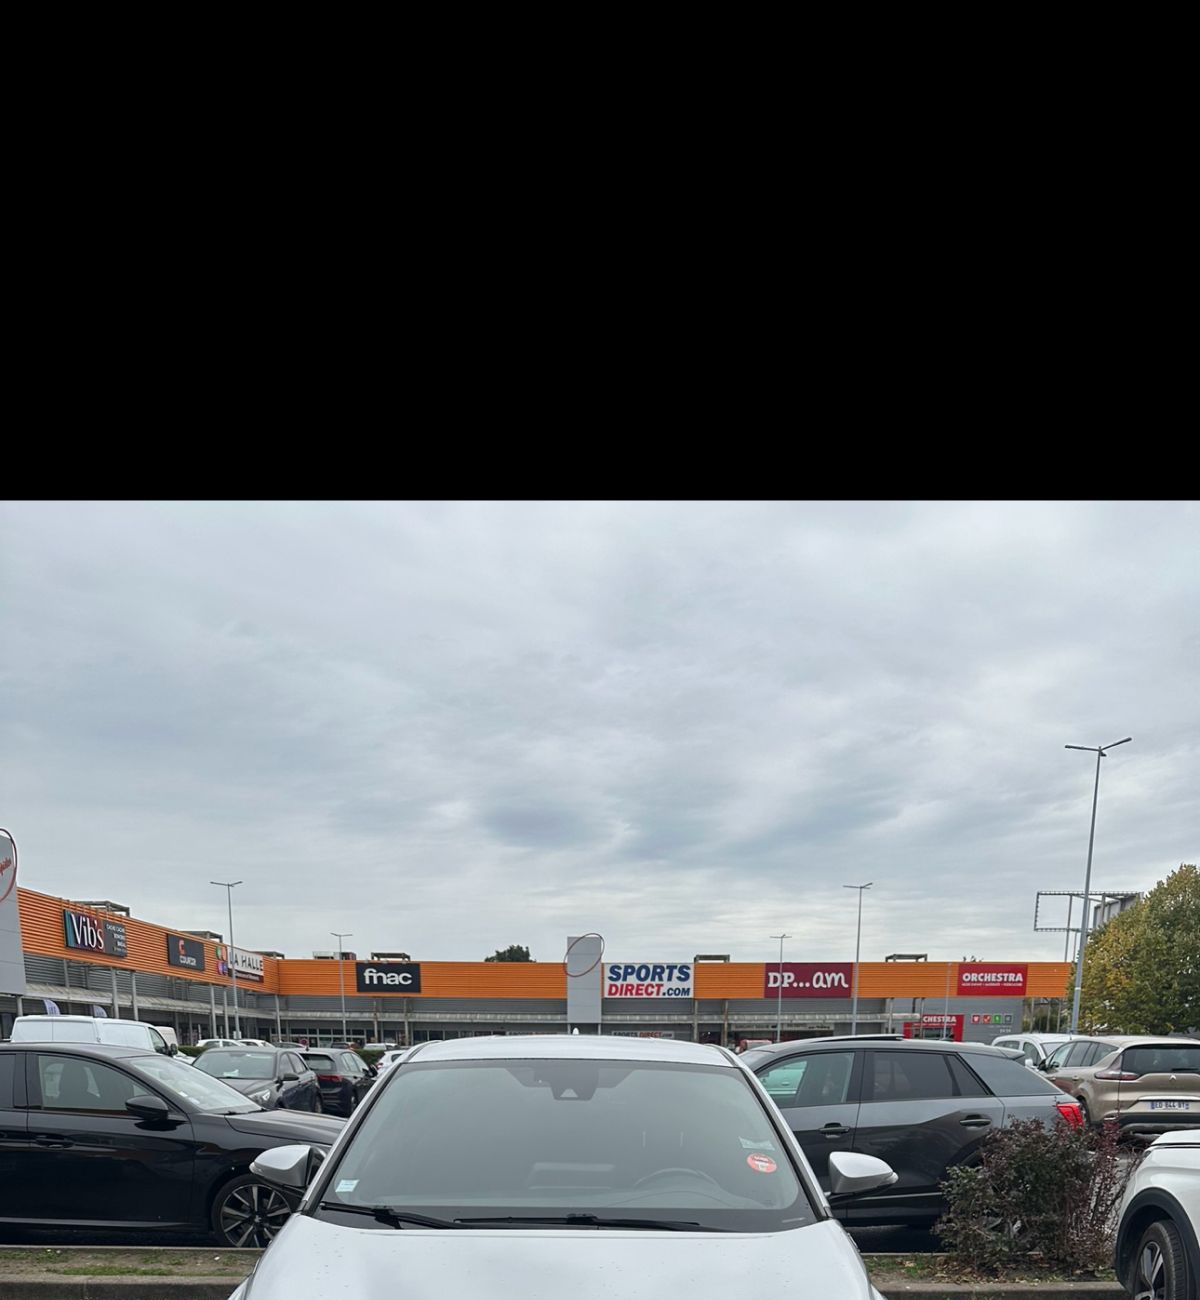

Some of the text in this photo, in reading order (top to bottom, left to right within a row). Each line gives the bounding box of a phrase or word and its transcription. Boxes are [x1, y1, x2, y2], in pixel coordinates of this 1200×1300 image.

[70, 913, 104, 949] Vib's
[241, 955, 263, 971] HALLE
[363, 968, 412, 985] fnac
[607, 964, 691, 982] SPORTS
[962, 972, 1024, 982] ORCHESTRA
[922, 1015, 957, 1023] CHESTRA
